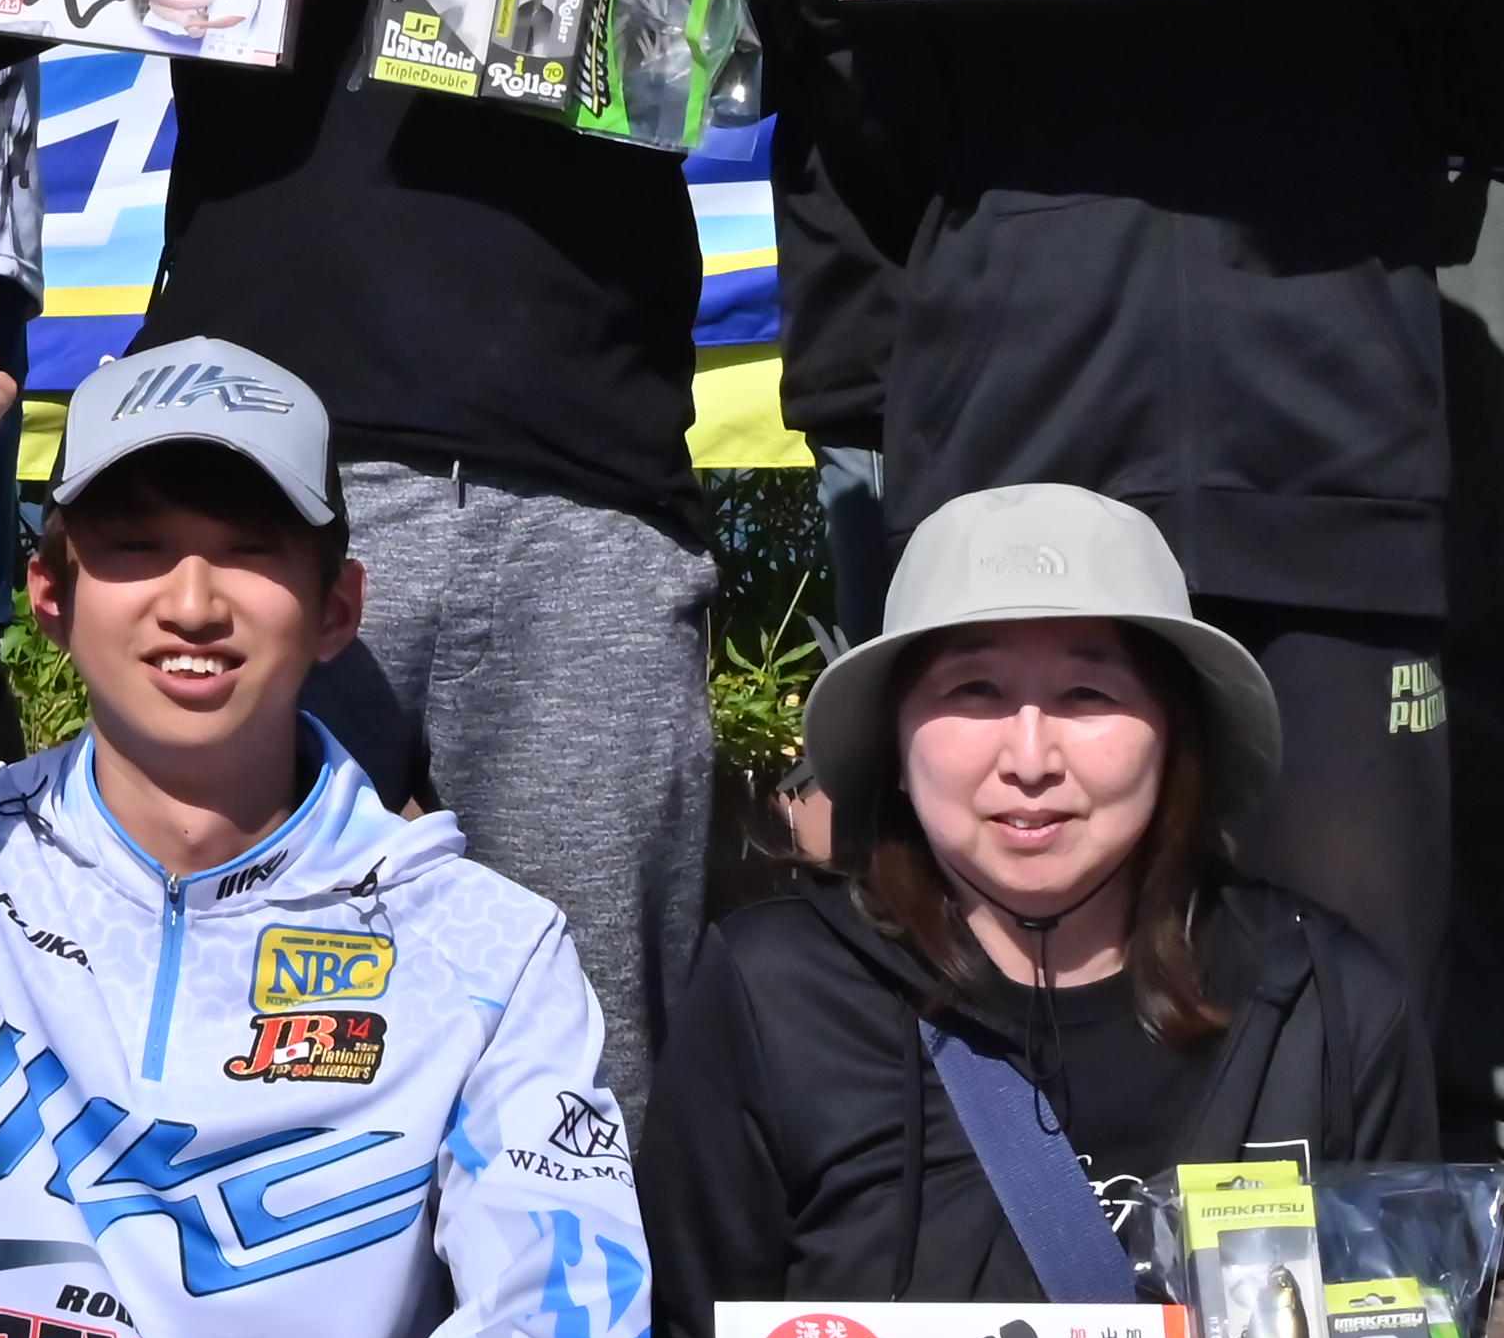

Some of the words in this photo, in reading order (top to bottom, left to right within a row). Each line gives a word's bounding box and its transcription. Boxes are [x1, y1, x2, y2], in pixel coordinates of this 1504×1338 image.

[384, 62, 469, 91] TripleDouble
[488, 62, 567, 98] Roller
[268, 948, 378, 996] NBC
[309, 1045, 377, 1065] Platinum
[1200, 1202, 1305, 1219] IMAKATSU
[1334, 1313, 1424, 1330] IMAKATSU
